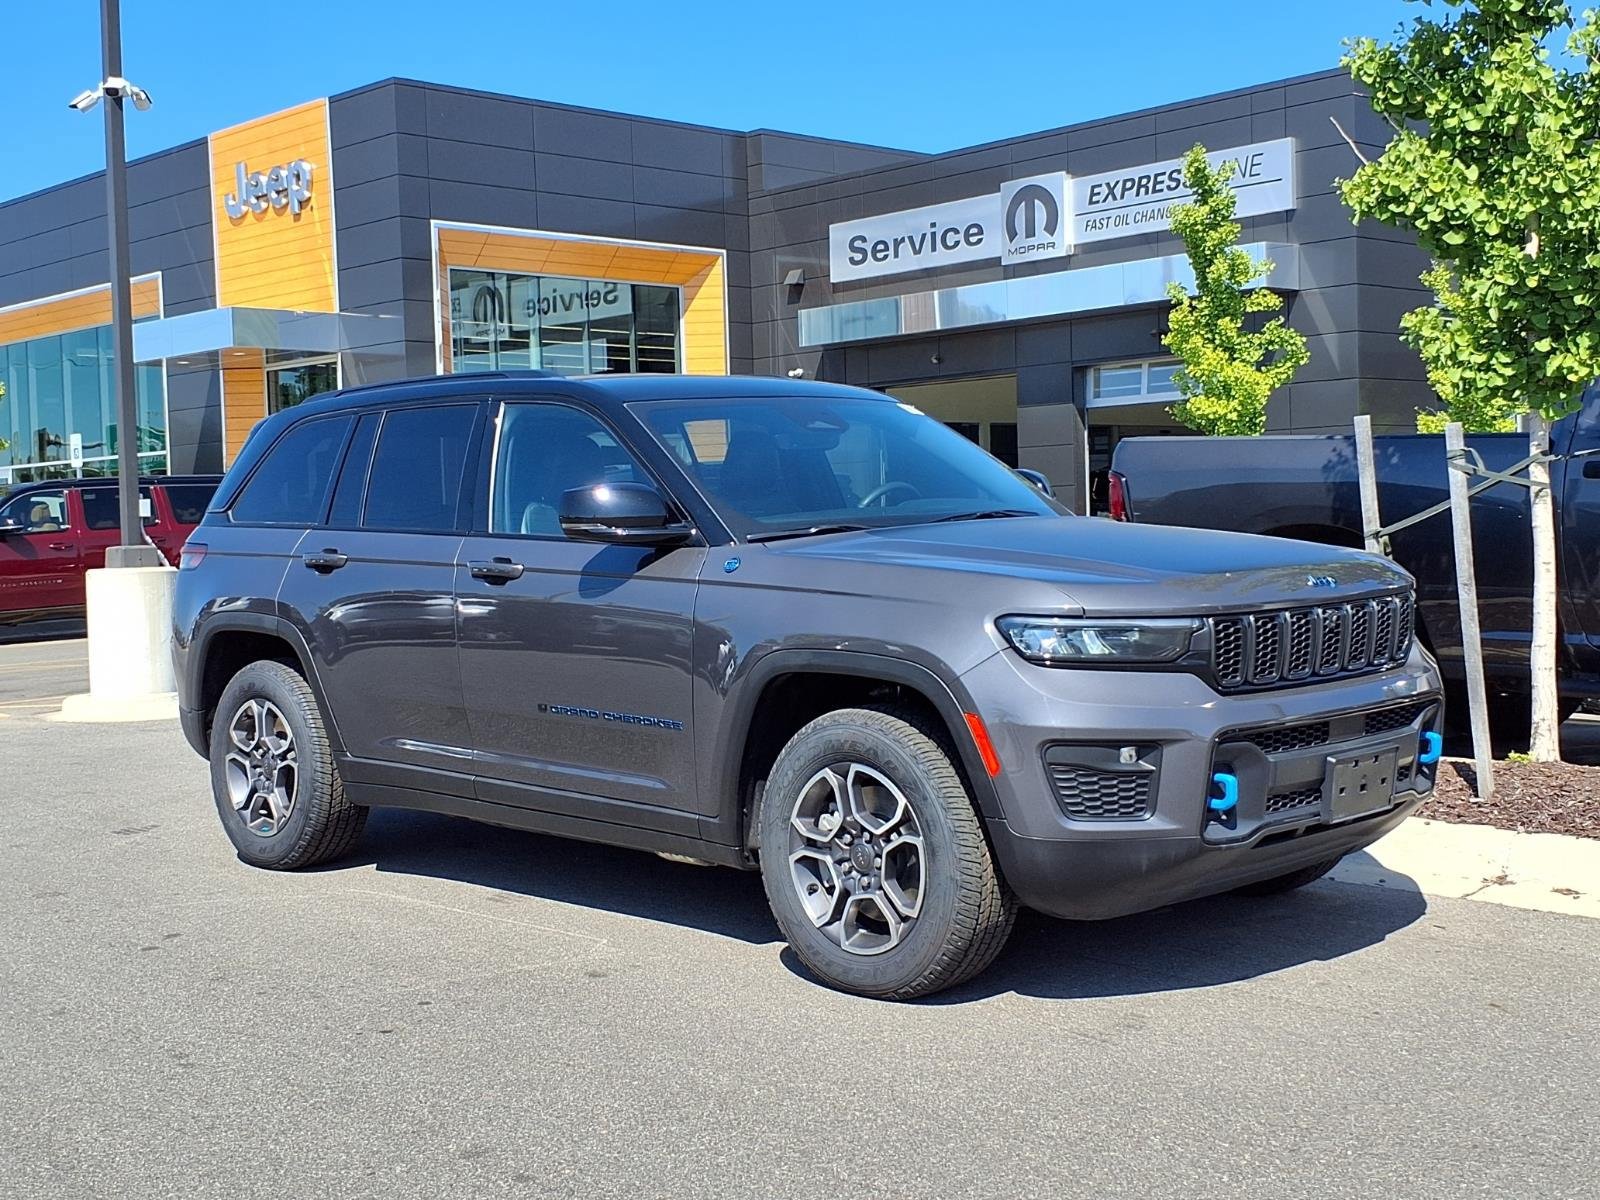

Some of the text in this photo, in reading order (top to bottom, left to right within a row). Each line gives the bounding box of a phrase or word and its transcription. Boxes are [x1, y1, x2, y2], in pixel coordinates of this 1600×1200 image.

[224, 159, 313, 218] Jeep
[1085, 206, 1173, 233] FAST OIL CHANG
[848, 221, 984, 266] Service
[1007, 241, 1056, 257] MOPAR
[550, 704, 684, 731] GRAND CHEROKEE
